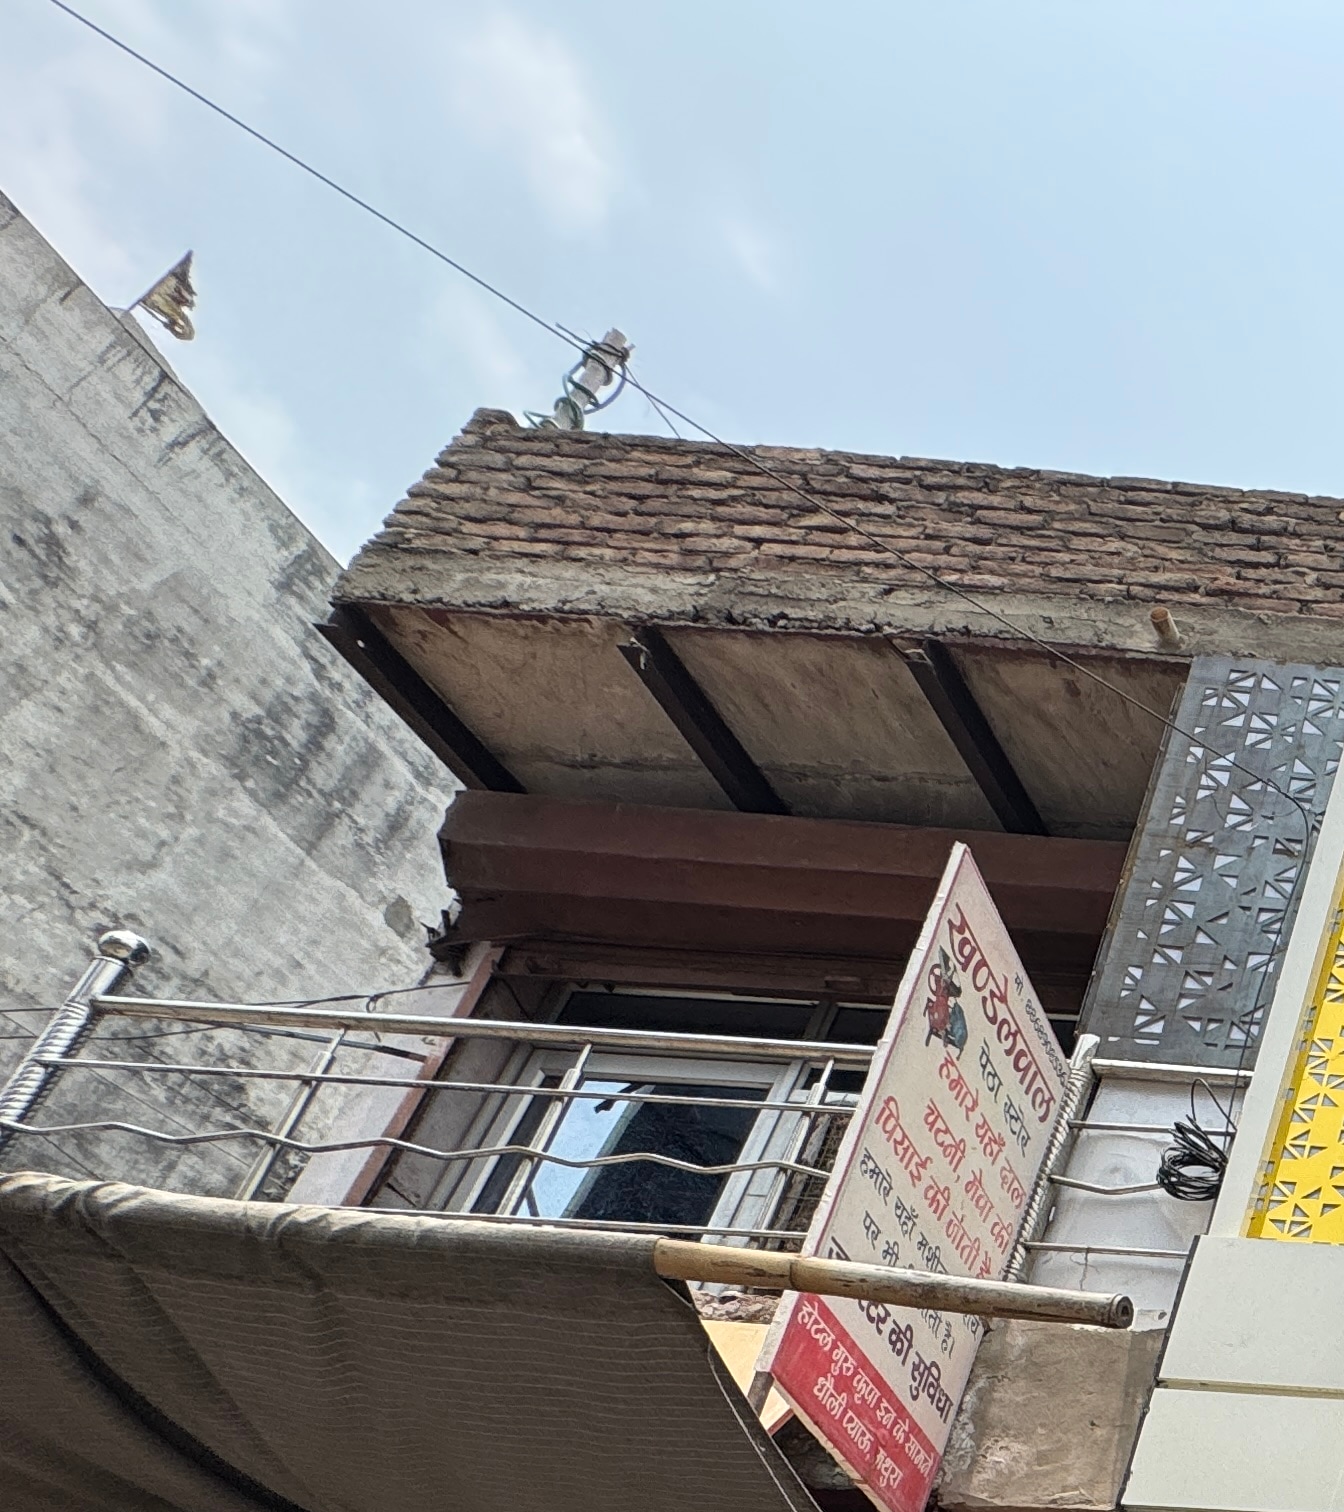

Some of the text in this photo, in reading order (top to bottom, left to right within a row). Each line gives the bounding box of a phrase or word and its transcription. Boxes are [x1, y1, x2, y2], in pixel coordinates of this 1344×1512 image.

[946, 902, 1056, 1123] खण्डेलवाल
[938, 1050, 979, 1122] हमारे
[874, 1094, 933, 1189] पिसाई
[923, 1174, 951, 1222] की
[990, 1213, 1013, 1256] की
[796, 1300, 836, 1352] होटल
[888, 1318, 954, 1425] की सुविधा
